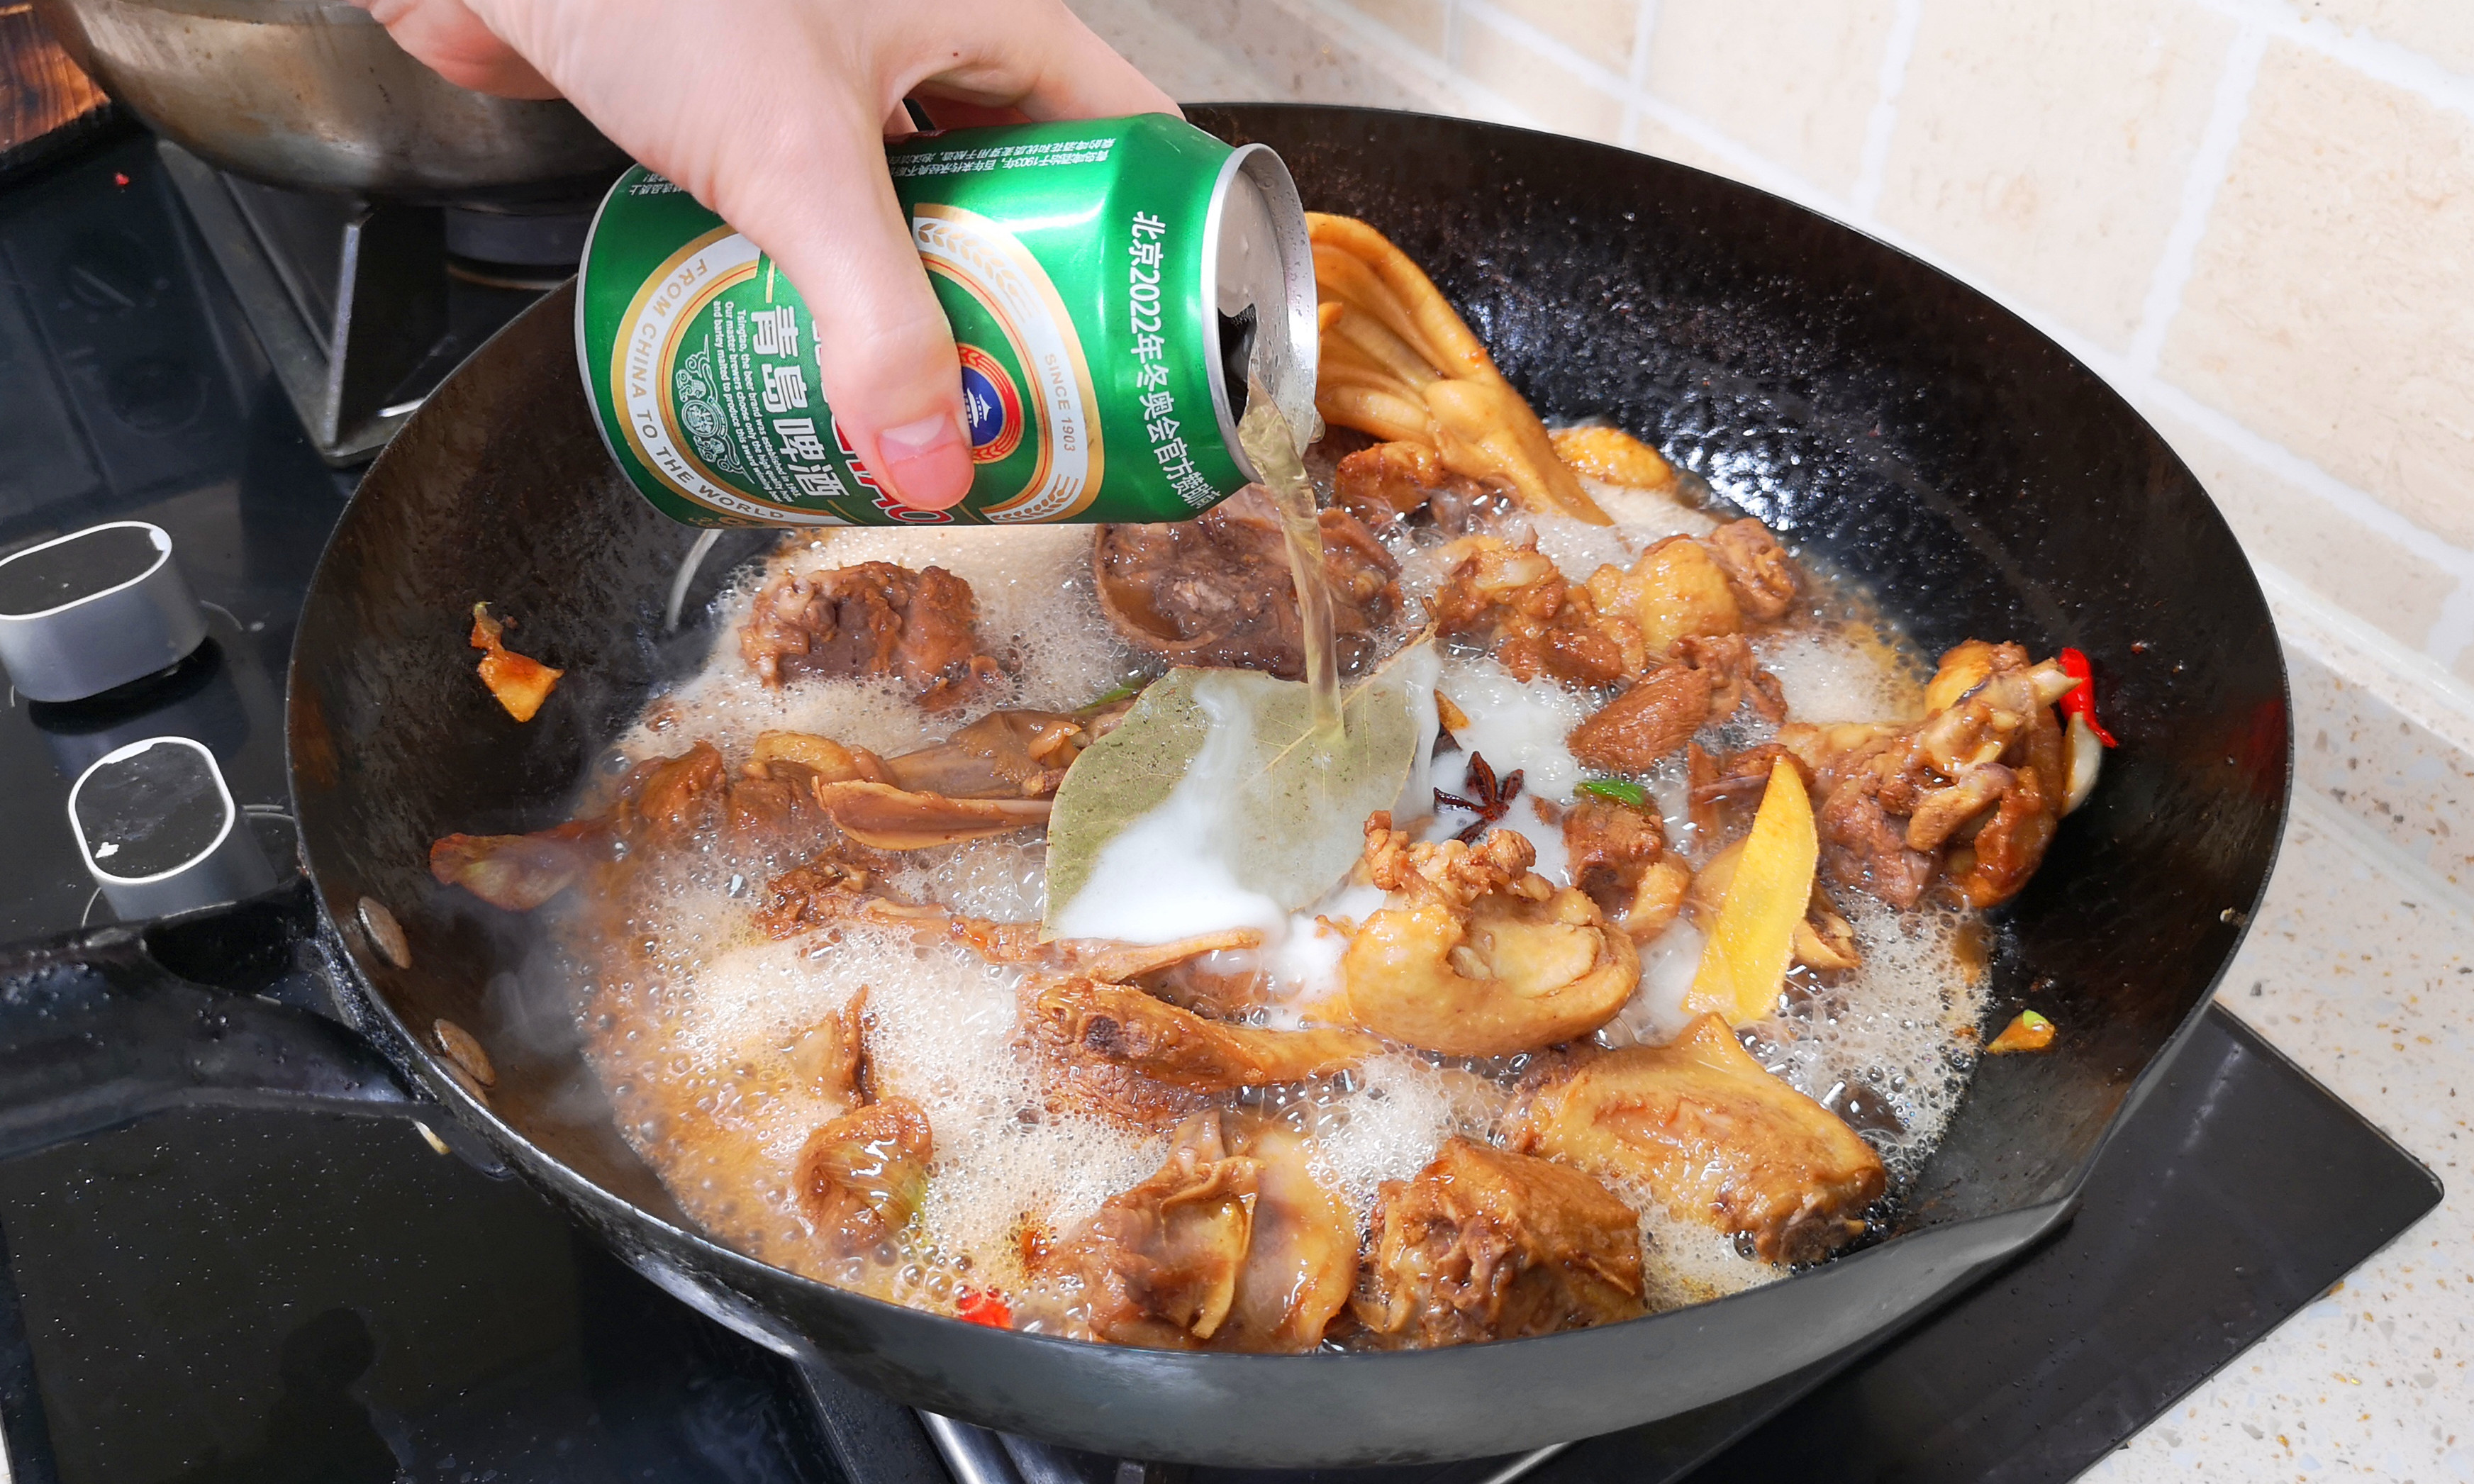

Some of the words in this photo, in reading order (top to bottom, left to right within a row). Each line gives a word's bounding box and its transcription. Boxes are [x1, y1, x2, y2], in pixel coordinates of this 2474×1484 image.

[652, 258, 708, 317] FROM
[713, 301, 723, 318] and
[725, 301, 734, 319] Our
[713, 319, 724, 348] barley
[726, 320, 736, 352] master
[736, 309, 747, 352] Tsingtao,
[632, 323, 657, 398] CHINA
[716, 349, 730, 381] malted
[729, 354, 742, 390] brewers
[741, 354, 750, 369] the
[1128, 211, 1221, 509] 北京2022年冬奥会官方赞助商
[723, 382, 731, 392] to
[744, 371, 754, 391] beer
[723, 393, 740, 428] produce
[736, 391, 750, 421] choose
[748, 392, 763, 417] brand
[752, 306, 849, 496] 青島啤酒
[1044, 353, 1070, 410] SINCE
[1061, 417, 1076, 452] 1903
[637, 409, 658, 438] TO
[735, 428, 747, 444] this
[745, 422, 757, 440] only
[755, 418, 767, 435] was
[741, 444, 759, 467] award
[752, 440, 762, 453] the
[762, 436, 787, 475] established
[656, 446, 694, 484] THE
[757, 454, 771, 469] high
[765, 470, 784, 490] quality
[698, 485, 784, 518] WORLD
